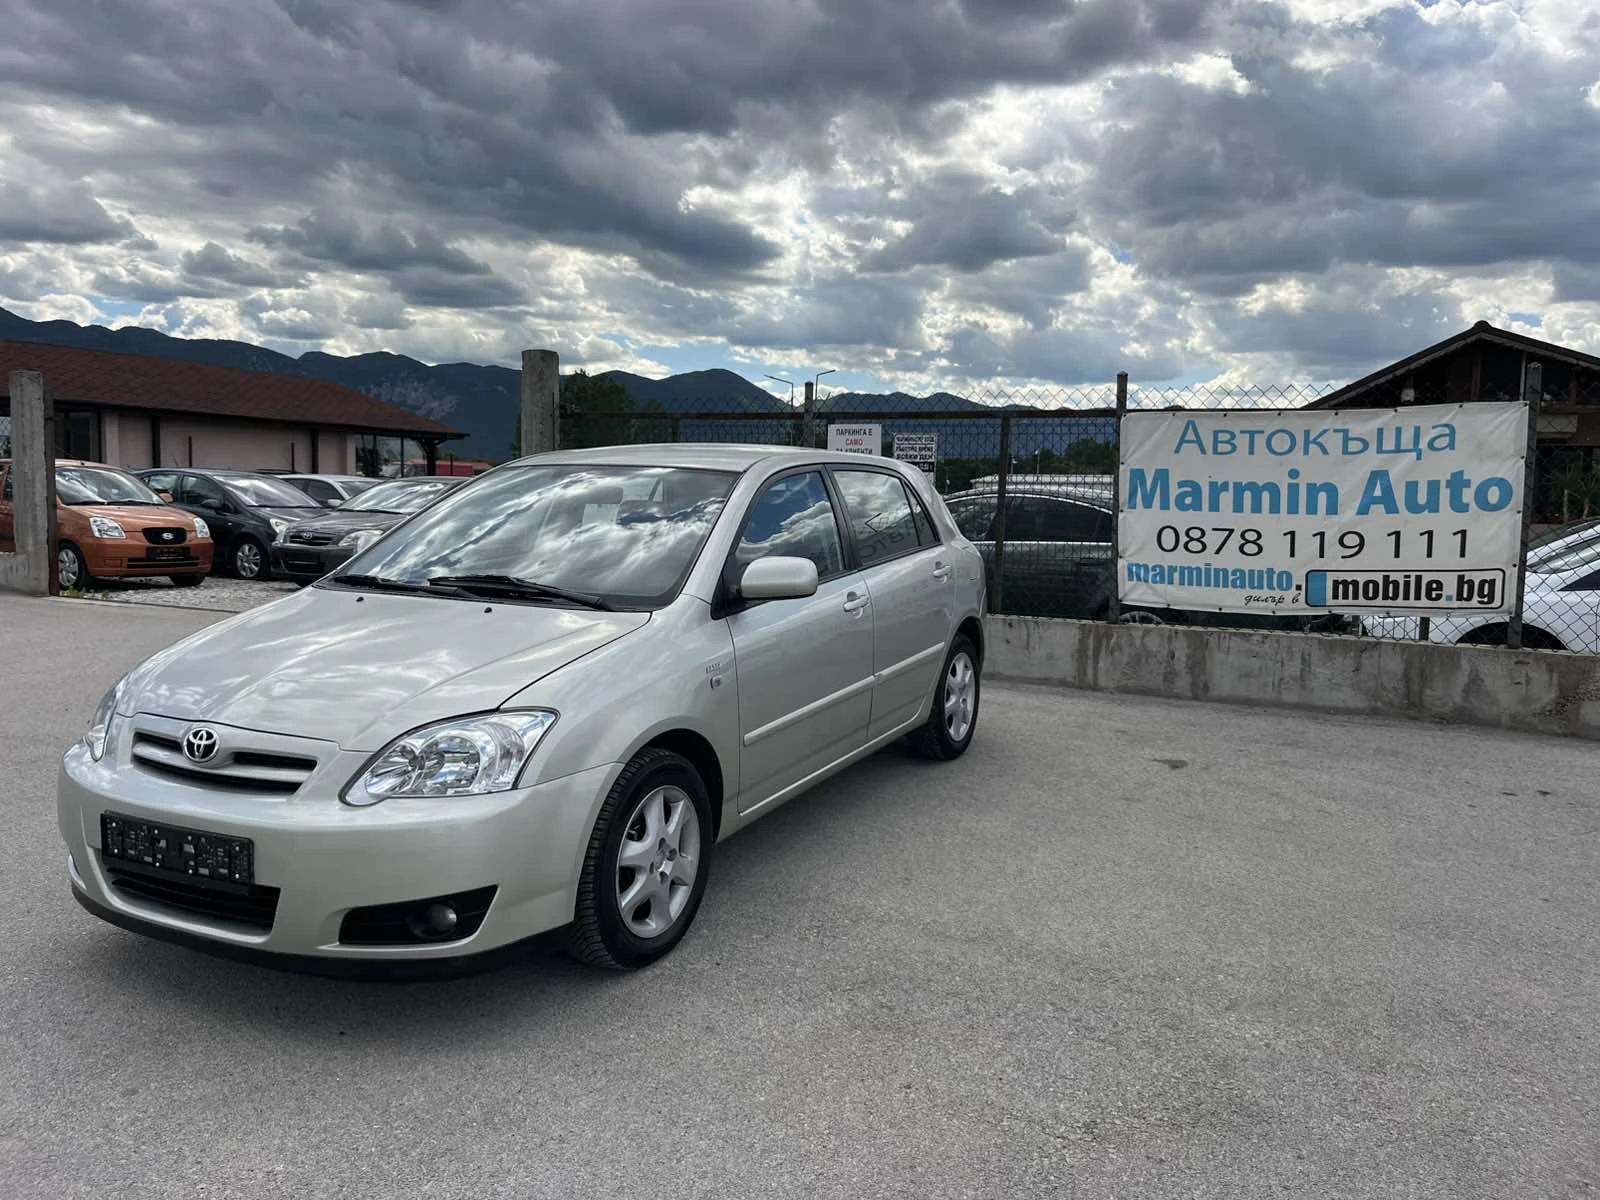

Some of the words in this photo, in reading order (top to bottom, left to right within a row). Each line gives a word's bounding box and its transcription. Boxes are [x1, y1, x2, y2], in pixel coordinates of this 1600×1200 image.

[835, 428, 867, 436] ПАРКИНГА
[868, 428, 873, 436] Е
[845, 438, 864, 446] САМО
[1174, 420, 1457, 460] Автокъща
[1127, 467, 1341, 517] Marmin
[1355, 469, 1515, 517] Auto
[1156, 525, 1264, 557] 0878
[1282, 530, 1366, 560] 119
[1386, 528, 1468, 559] 111
[1331, 574, 1497, 605] mobile.bg
